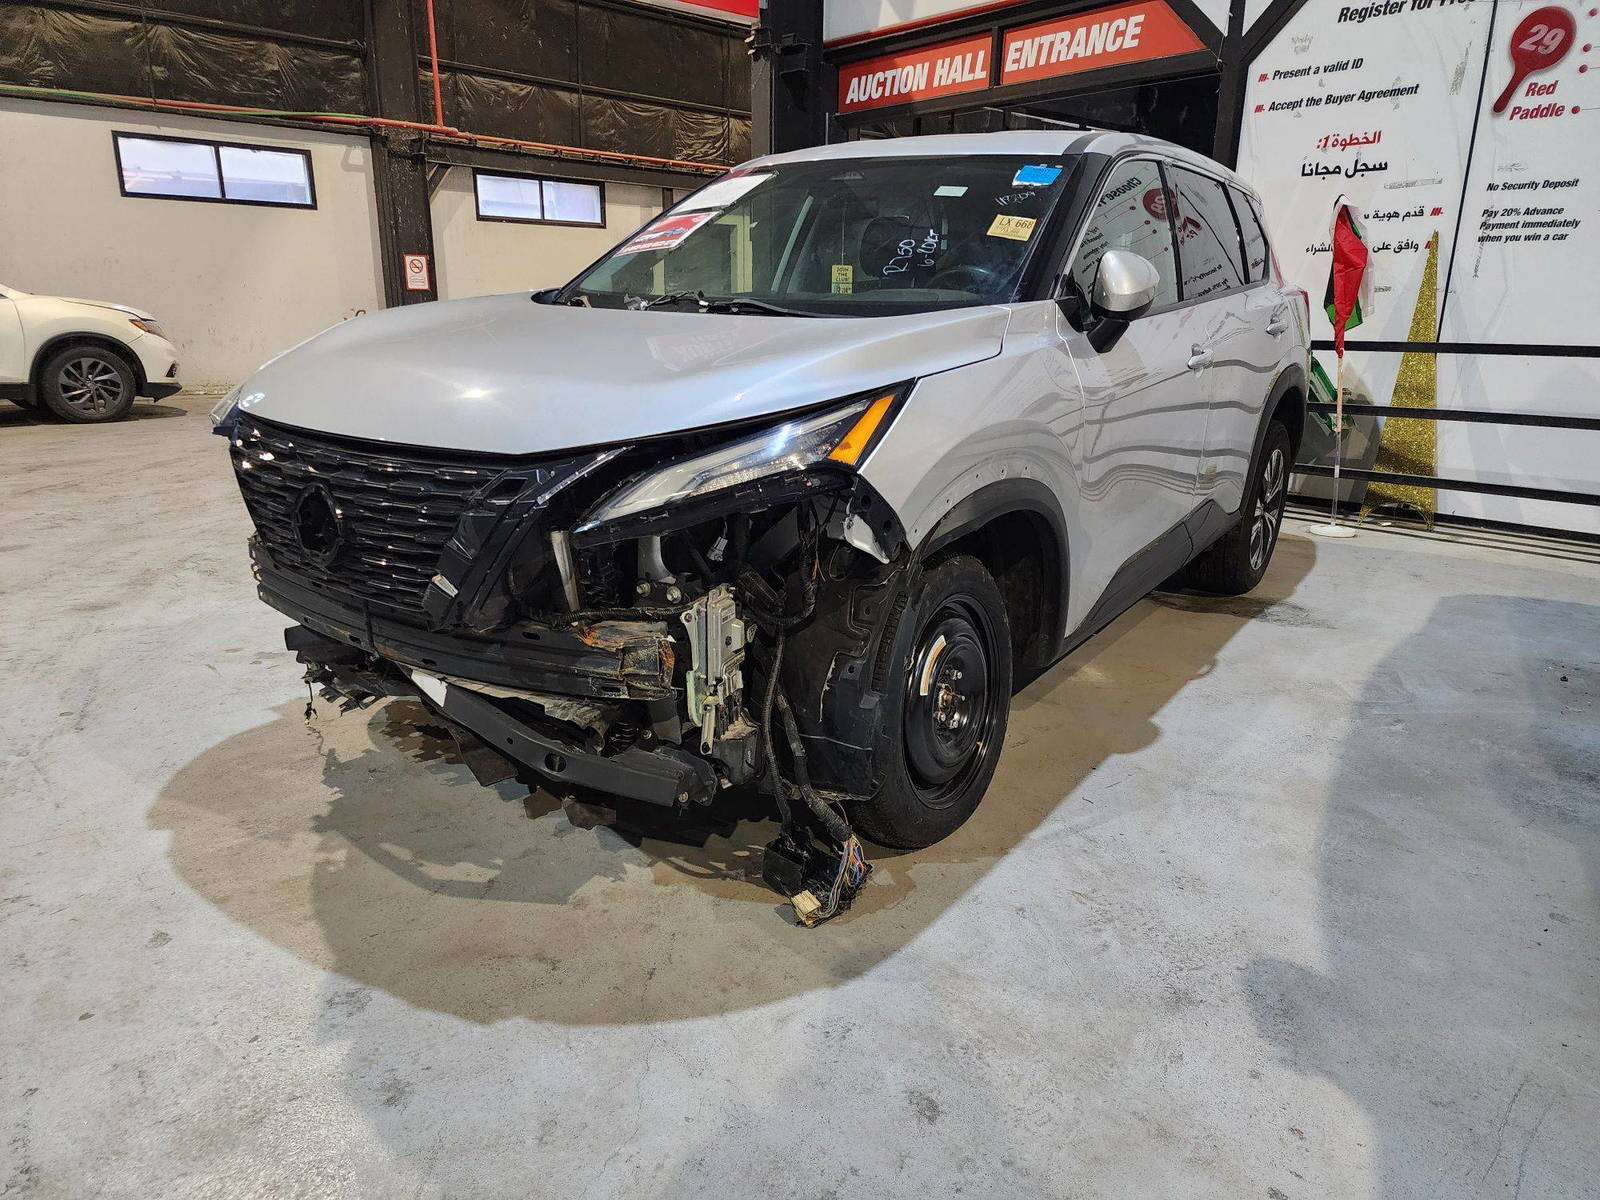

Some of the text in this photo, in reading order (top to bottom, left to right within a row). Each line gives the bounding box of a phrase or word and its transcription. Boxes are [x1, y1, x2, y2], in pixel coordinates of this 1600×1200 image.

[1337, 0, 1406, 23] Register
[1518, 24, 1566, 55] 29
[845, 14, 1145, 104] AUCTION HALL ENTRANCE
[1272, 58, 1364, 81] Present a valid ID
[1268, 83, 1420, 112] Accept the Buyer Agreement
[1525, 80, 1559, 97] Red
[1509, 103, 1565, 121] Paddle
[1486, 178, 1580, 192] No Security Deposit
[1481, 207, 1564, 219] Pay 20% Advance
[1479, 219, 1581, 231] Payment immediately
[1477, 234, 1502, 243] when
[1503, 235, 1521, 244] you
[1523, 232, 1541, 242] win
[1552, 232, 1569, 241] car
